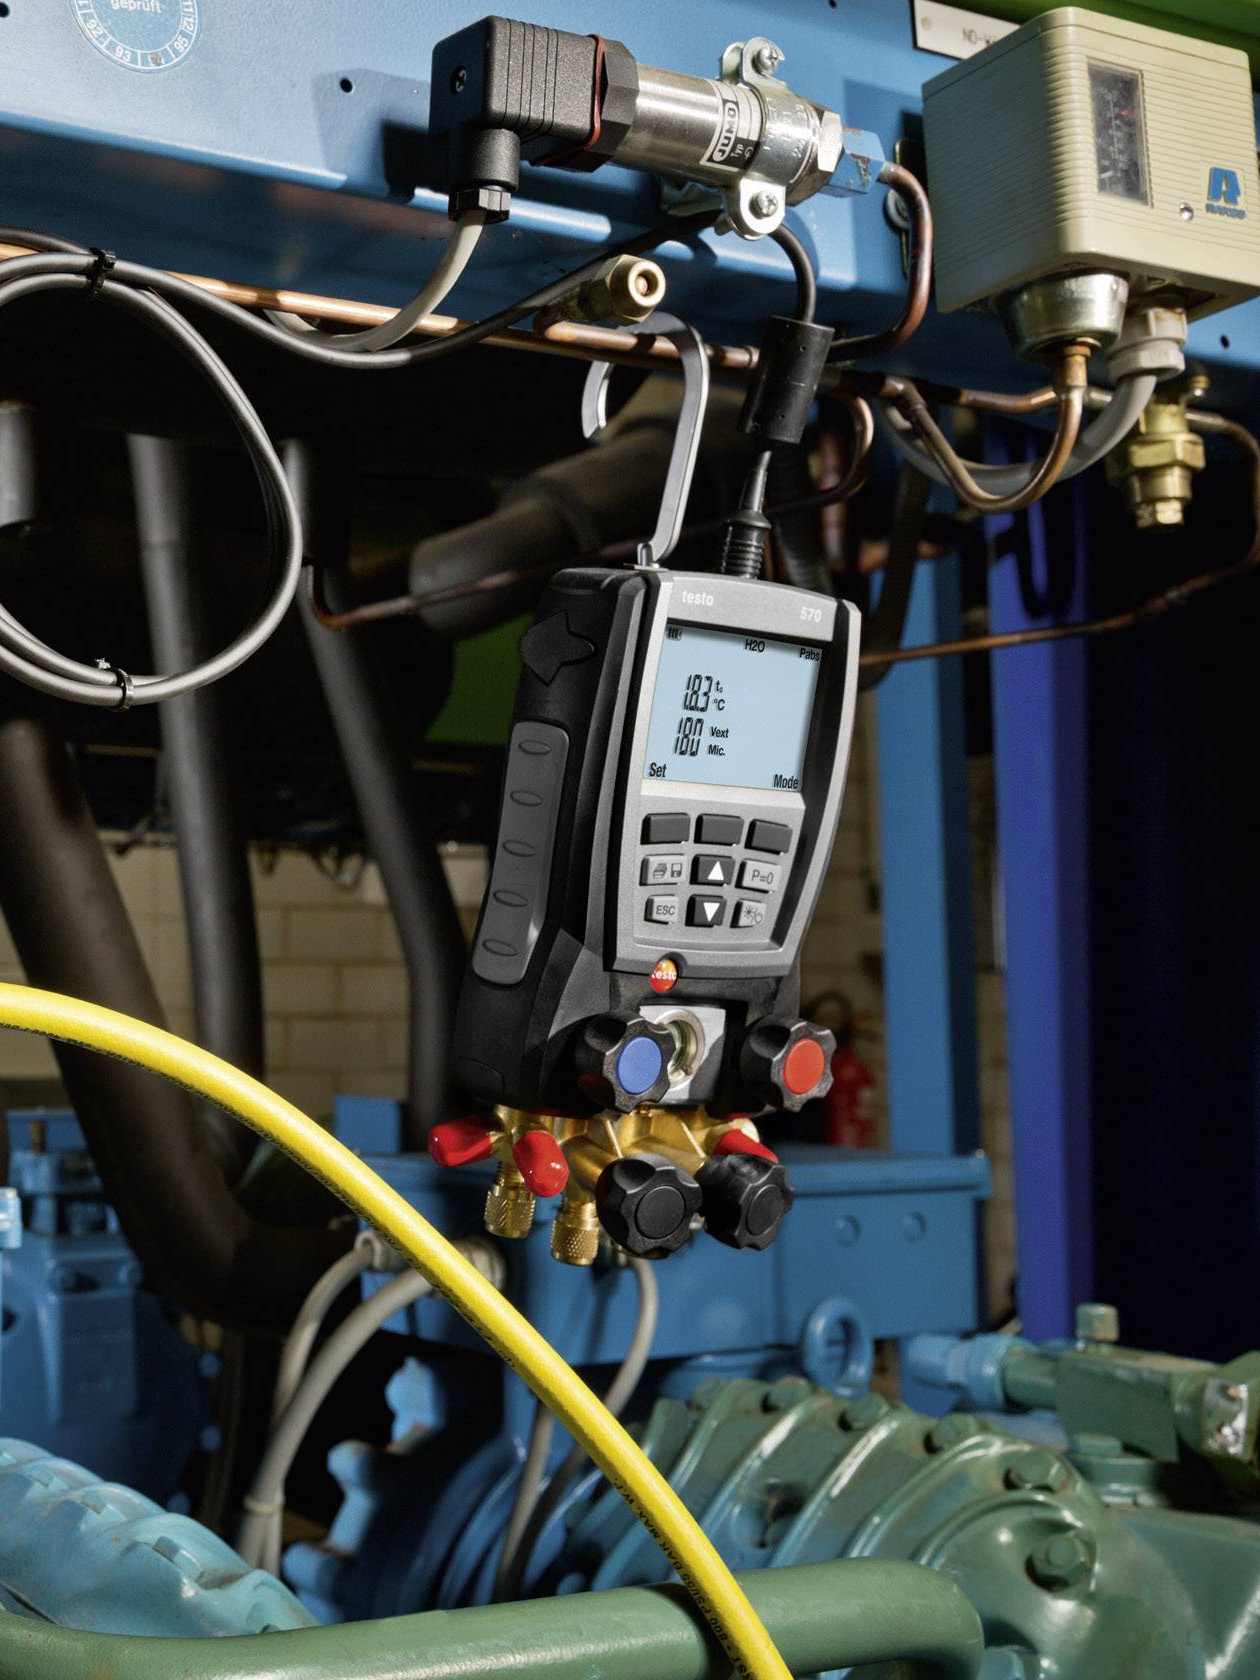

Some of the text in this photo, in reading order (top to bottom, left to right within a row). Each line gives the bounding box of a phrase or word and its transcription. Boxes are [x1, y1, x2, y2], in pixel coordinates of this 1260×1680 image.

[86, 19, 103, 37] 92
[174, 35, 189, 52] 95
[115, 46, 131, 62] 93
[719, 107, 736, 157] JUMO
[731, 143, 745, 158] Typ
[682, 590, 714, 607] testo
[800, 606, 822, 623] 570
[744, 638, 765, 653] H2O
[799, 648, 820, 662] Pabs
[710, 726, 730, 738] Vext
[648, 762, 667, 778] Set
[773, 774, 799, 790] Mode
[656, 904, 676, 916] ESC
